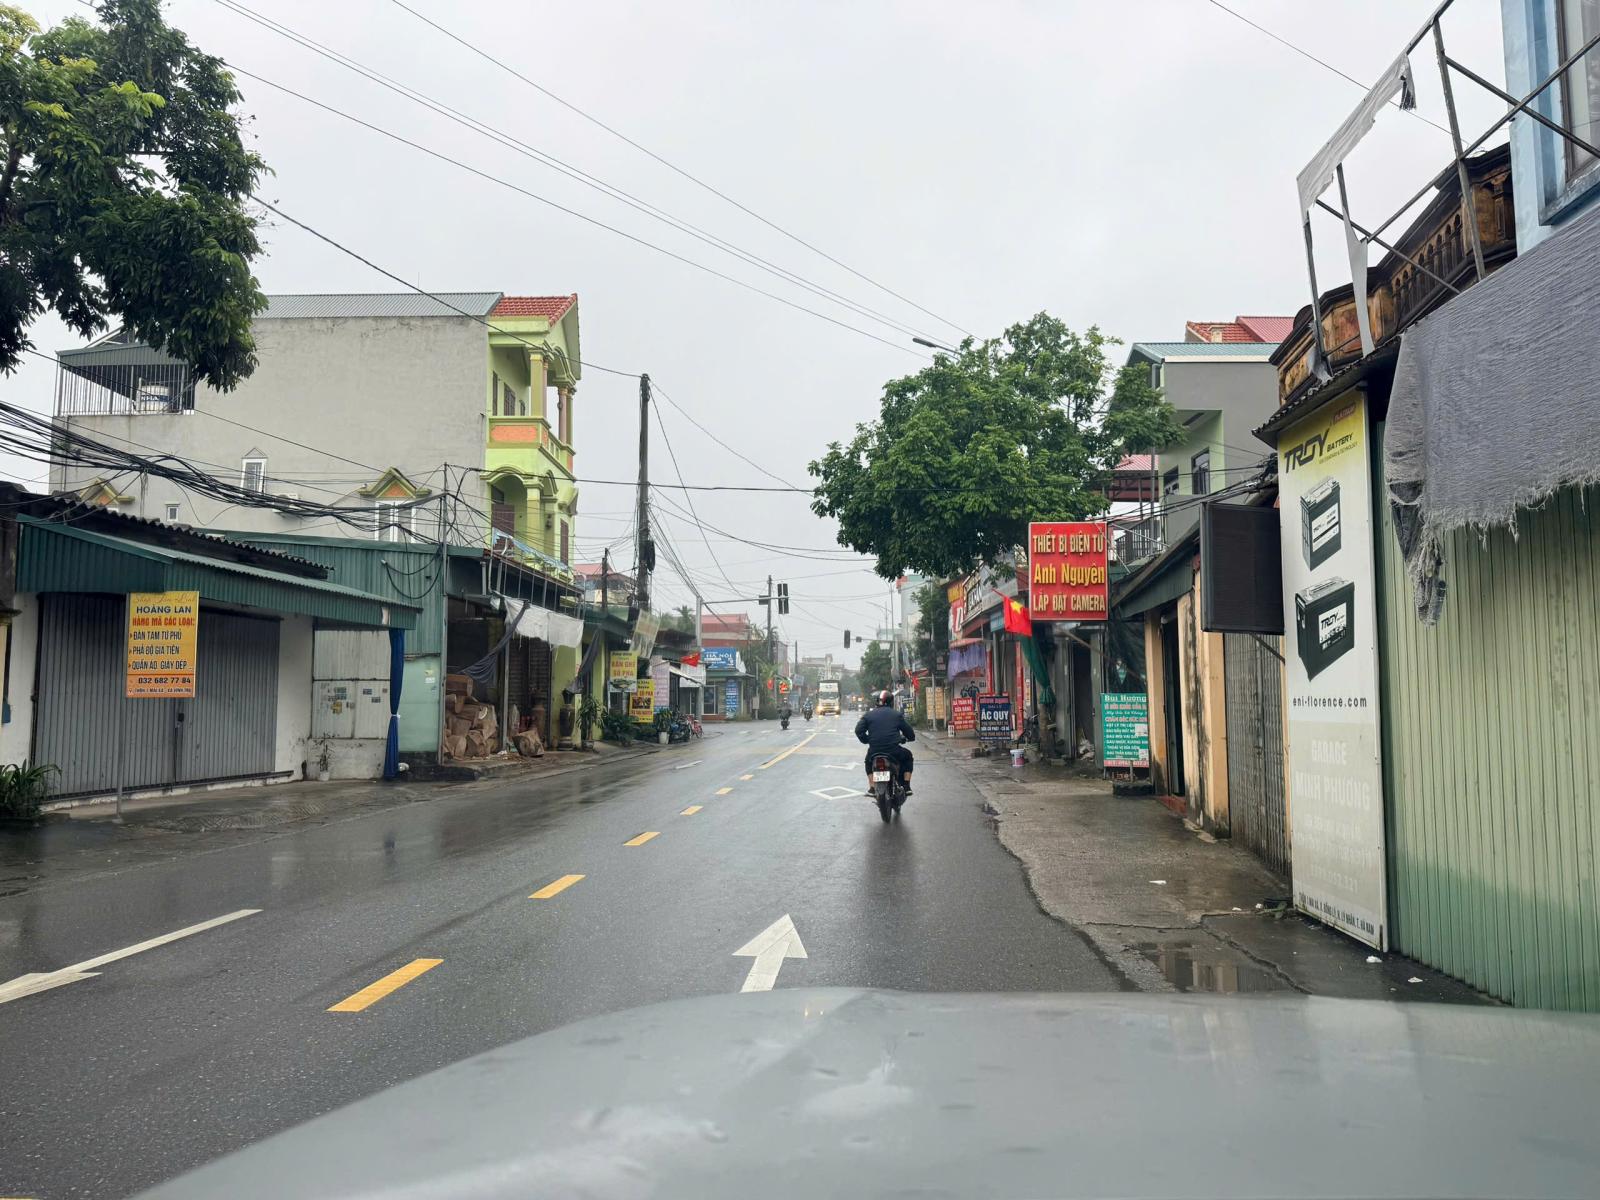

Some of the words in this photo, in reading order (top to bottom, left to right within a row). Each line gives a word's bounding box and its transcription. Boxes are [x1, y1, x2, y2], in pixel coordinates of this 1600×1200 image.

[1284, 426, 1331, 474] TROY
[1327, 432, 1353, 453] BATTERY
[1033, 528, 1056, 553] THIẾT
[1059, 534, 1067, 556] BỊ
[1070, 530, 1090, 556] ĐIỆN
[1034, 563, 1056, 584] Anh
[136, 604, 171, 613] HOÀNG
[1052, 592, 1067, 614] ĐẶT
[1071, 594, 1105, 611] CAMERA
[132, 616, 150, 626] HÀNG
[164, 616, 177, 626] CÁC
[1293, 696, 1367, 708] eni-florence.com
[993, 711, 1009, 721] QUY
